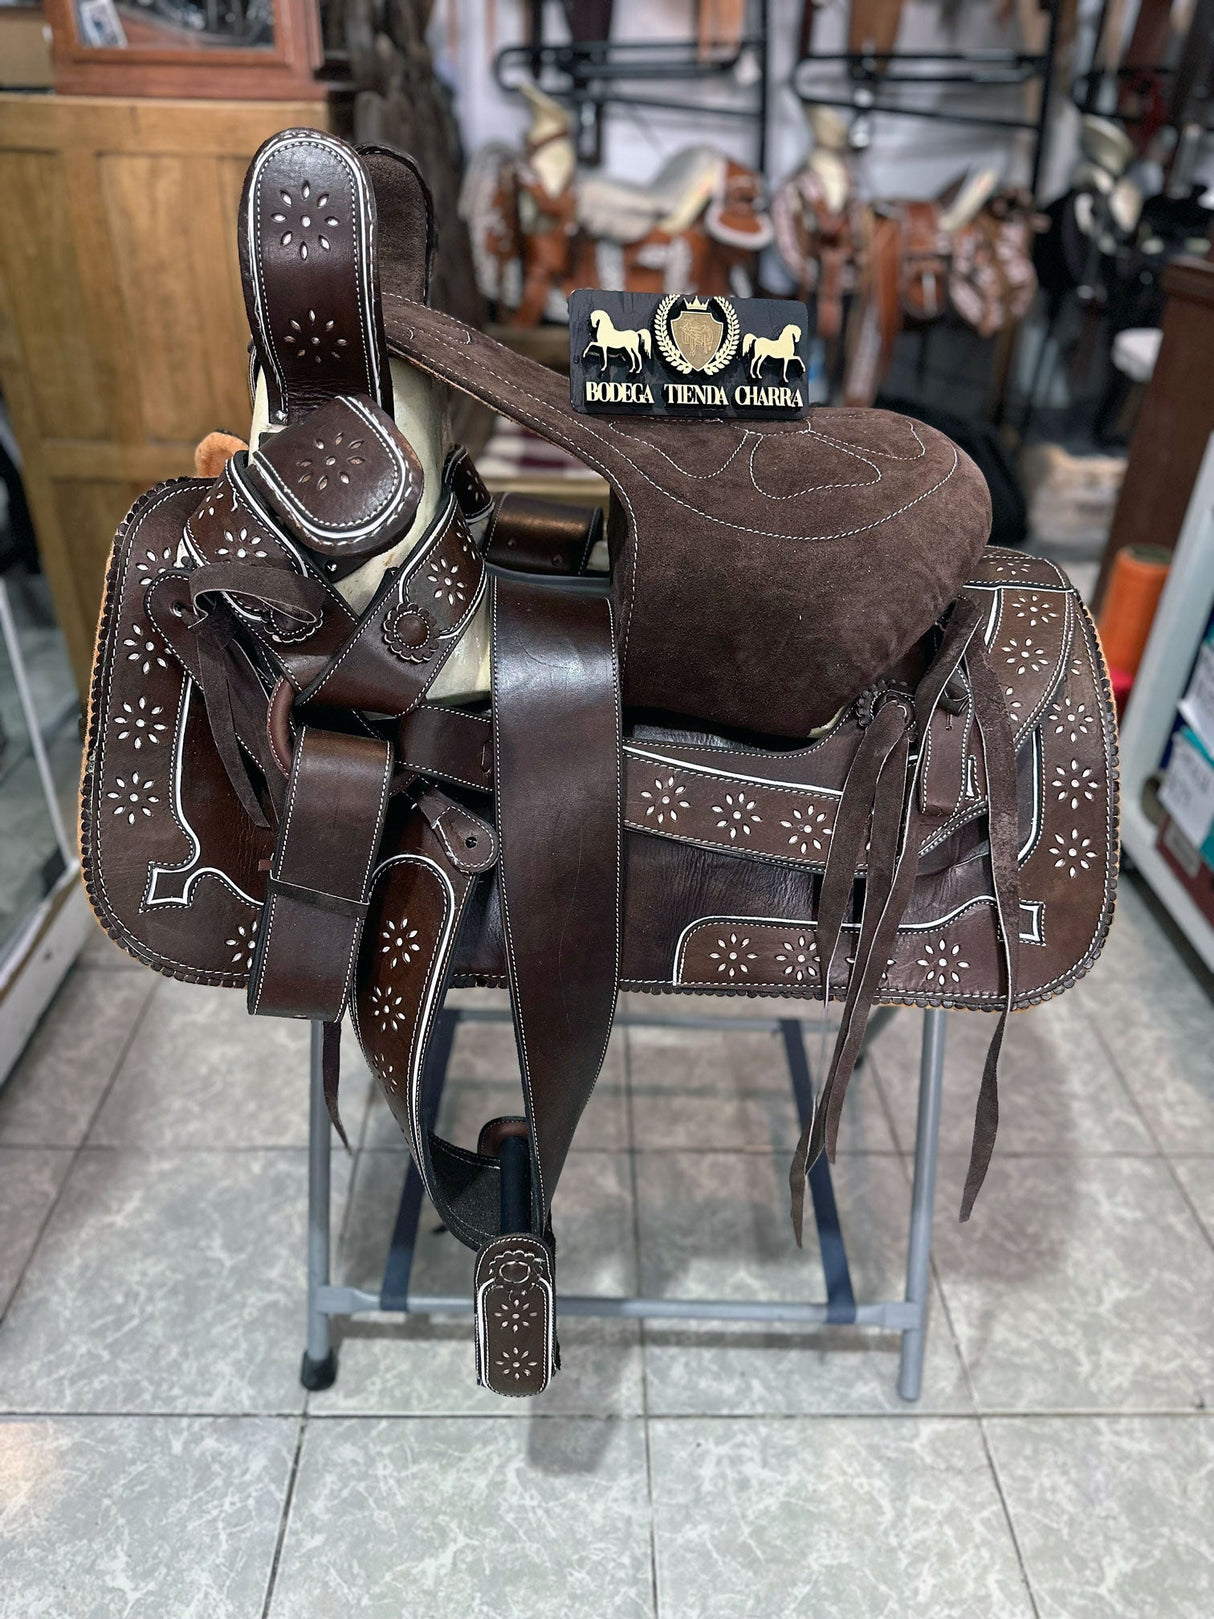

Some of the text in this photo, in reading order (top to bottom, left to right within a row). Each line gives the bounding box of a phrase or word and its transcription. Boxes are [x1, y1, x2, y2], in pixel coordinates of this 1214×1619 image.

[585, 381, 804, 407] BODEGA TIENDA CHARRA
